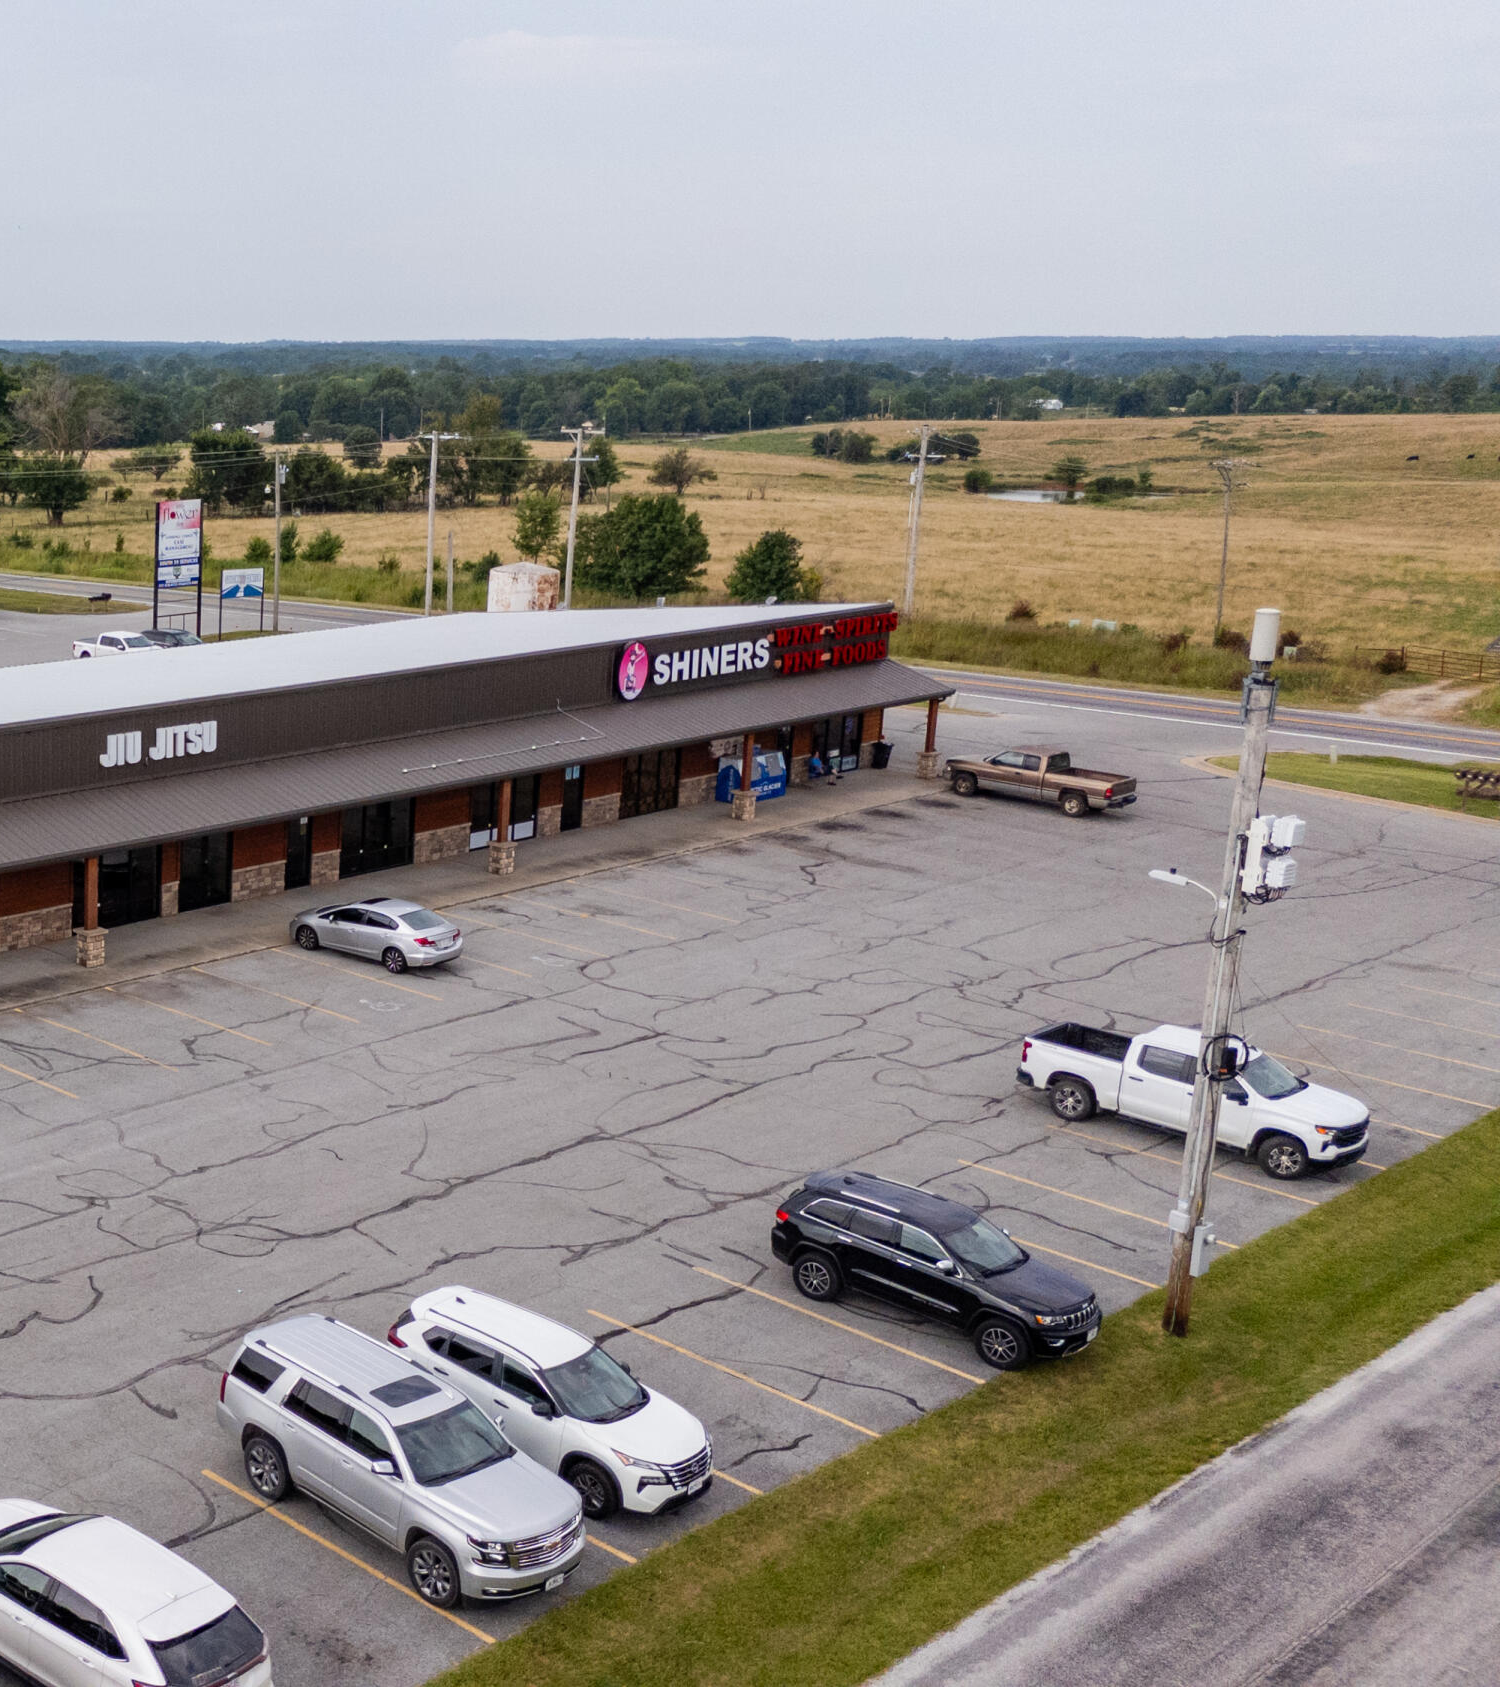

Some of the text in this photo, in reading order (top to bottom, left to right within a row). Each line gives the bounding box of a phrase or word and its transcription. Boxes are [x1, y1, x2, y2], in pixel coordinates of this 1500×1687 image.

[162, 508, 198, 524] flower
[775, 612, 898, 648] WINE SPIRITS
[653, 638, 770, 686] SHINERS
[781, 640, 886, 675] FINE FOODS
[99, 720, 218, 768] JIU JITSU
